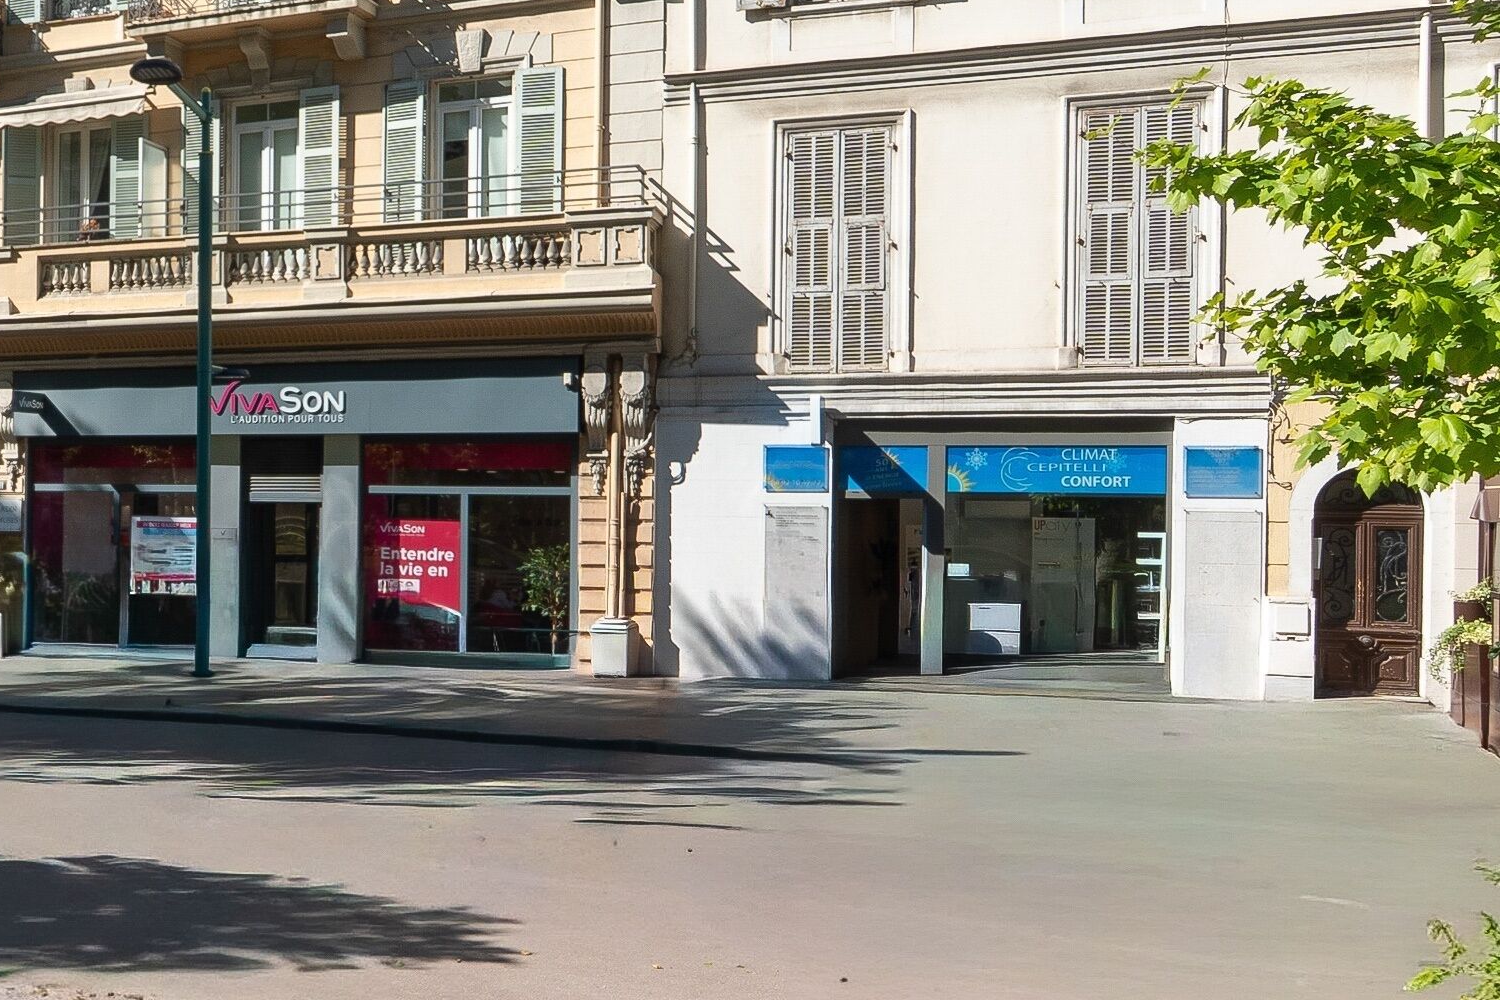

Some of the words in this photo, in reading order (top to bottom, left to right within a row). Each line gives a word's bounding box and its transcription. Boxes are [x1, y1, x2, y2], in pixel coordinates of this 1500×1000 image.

[230, 414, 285, 424] L'AUDITION
[288, 414, 314, 423] POUR
[315, 413, 344, 423] TOUS
[1061, 448, 1118, 461] CLIMAT
[1027, 462, 1107, 472] CEPITELLI
[1061, 475, 1132, 488] CONFORT
[380, 547, 454, 562] Entendre
[380, 562, 394, 575] la
[398, 562, 423, 576] vie
[427, 565, 448, 577] en
